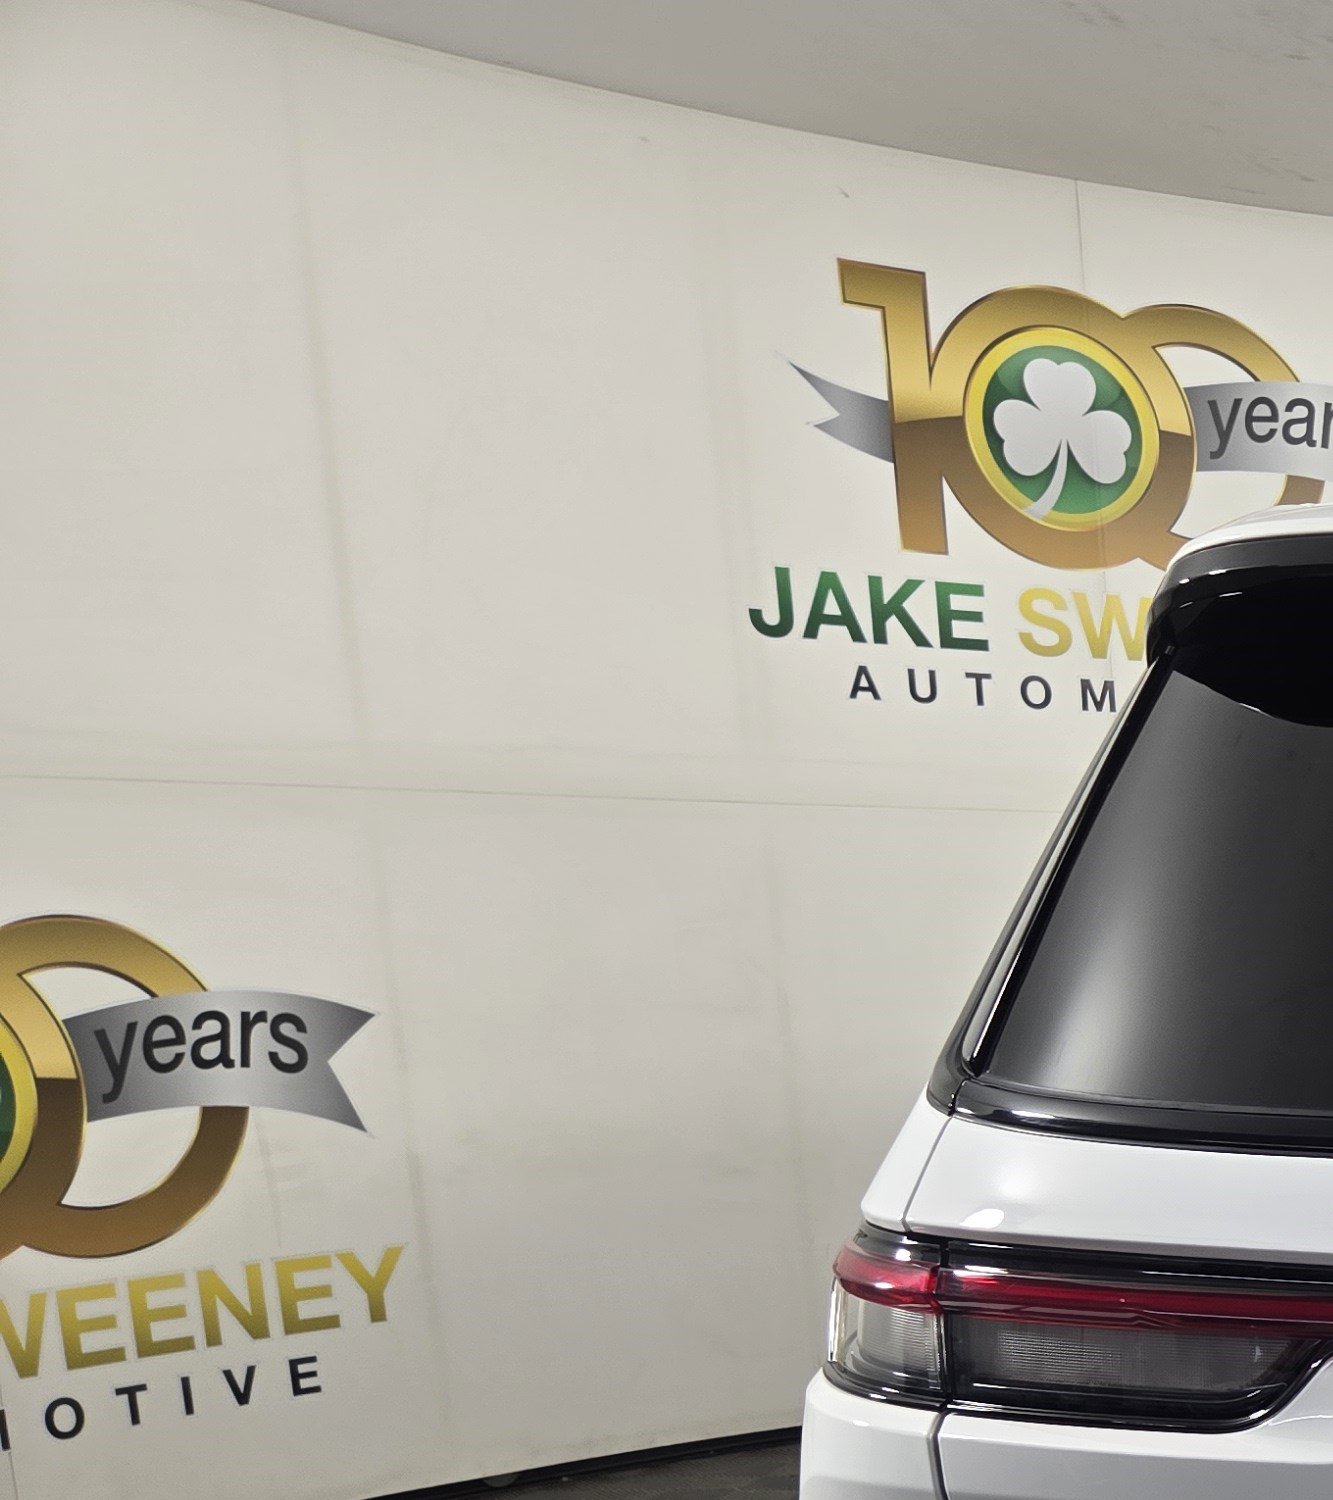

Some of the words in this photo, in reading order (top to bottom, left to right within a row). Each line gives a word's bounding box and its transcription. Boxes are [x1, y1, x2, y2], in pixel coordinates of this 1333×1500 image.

[748, 566, 990, 652] JAKE
[92, 1009, 309, 1104] years
[0, 1355, 322, 1452] OTIVE
